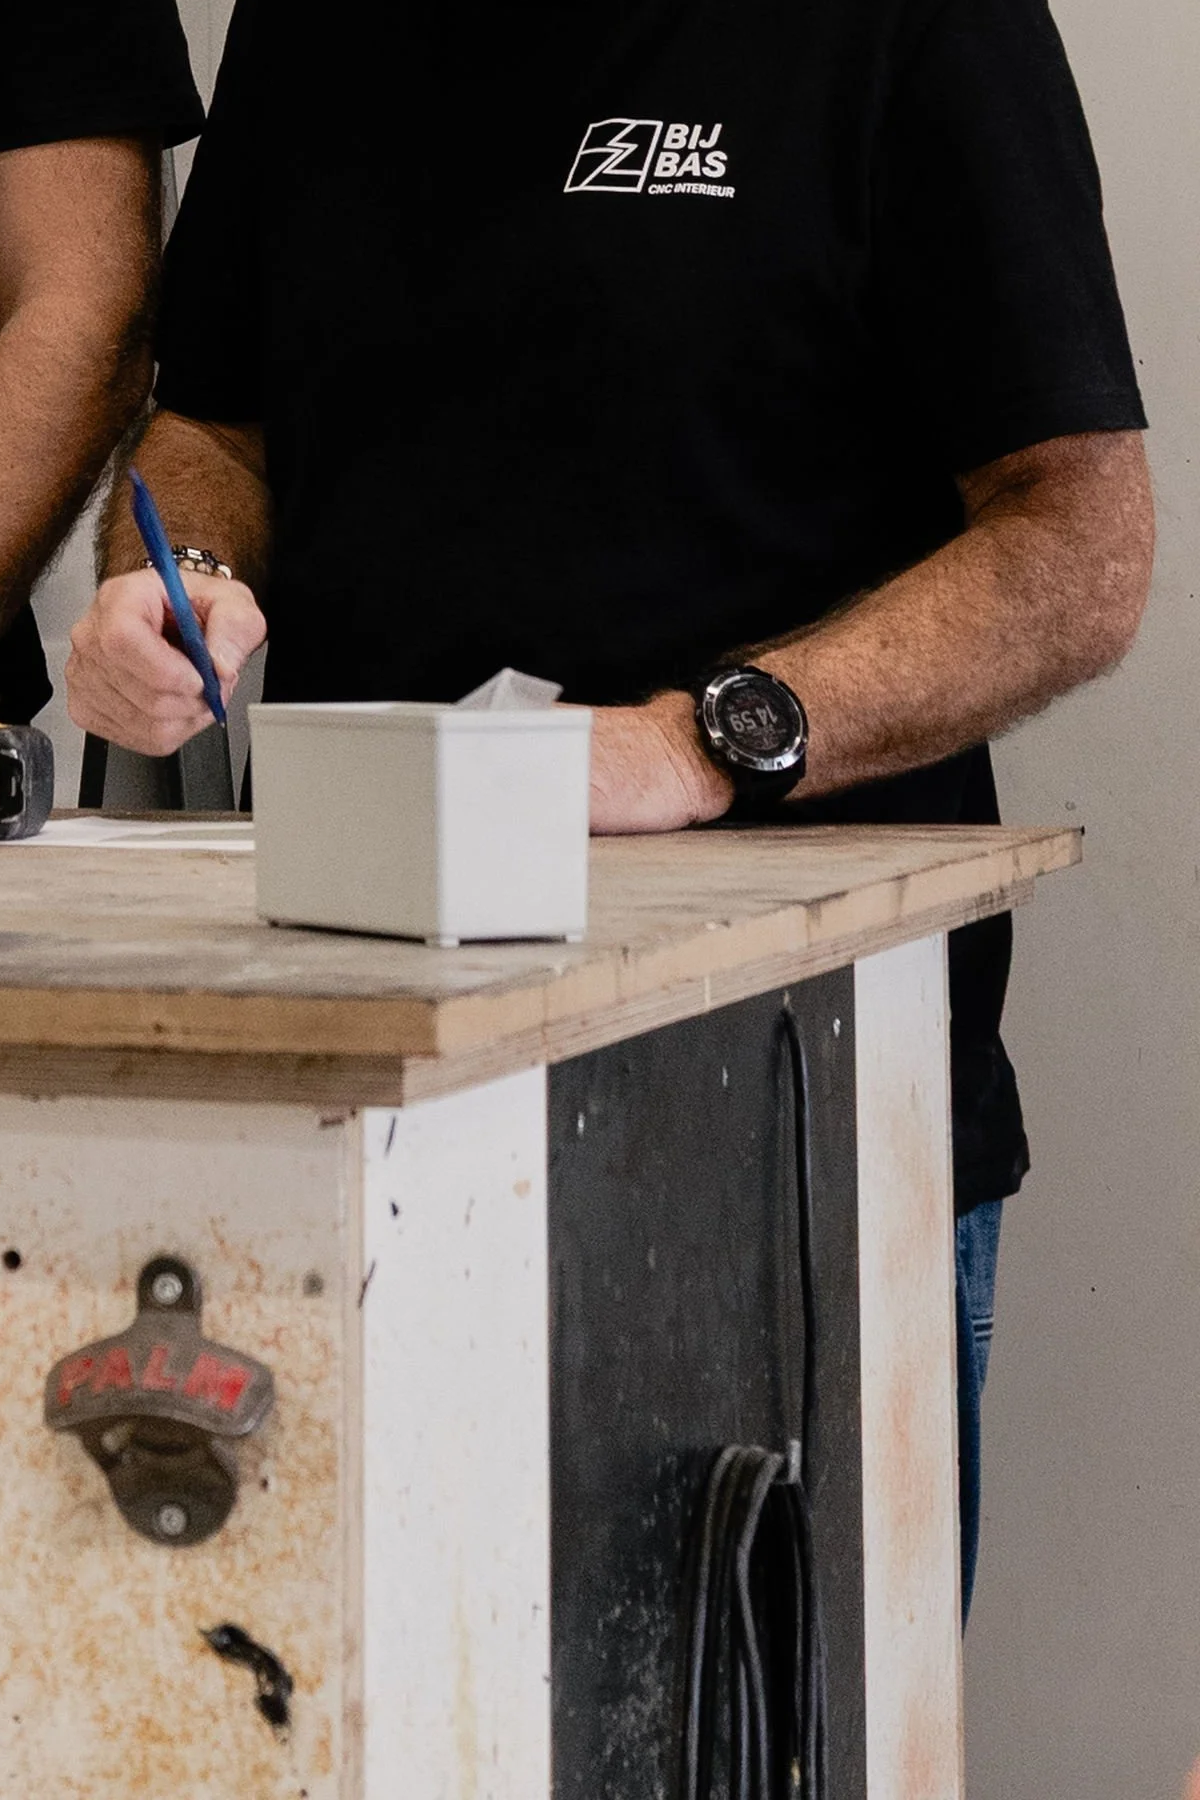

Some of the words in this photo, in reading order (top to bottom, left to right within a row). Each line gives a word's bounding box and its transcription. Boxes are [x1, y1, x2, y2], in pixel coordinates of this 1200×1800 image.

[663, 123, 723, 150] BIJ
[654, 151, 728, 178] BAS
[648, 184, 674, 195] CNC
[674, 183, 736, 198] INTERIEUR
[58, 1346, 252, 1409] PALM
